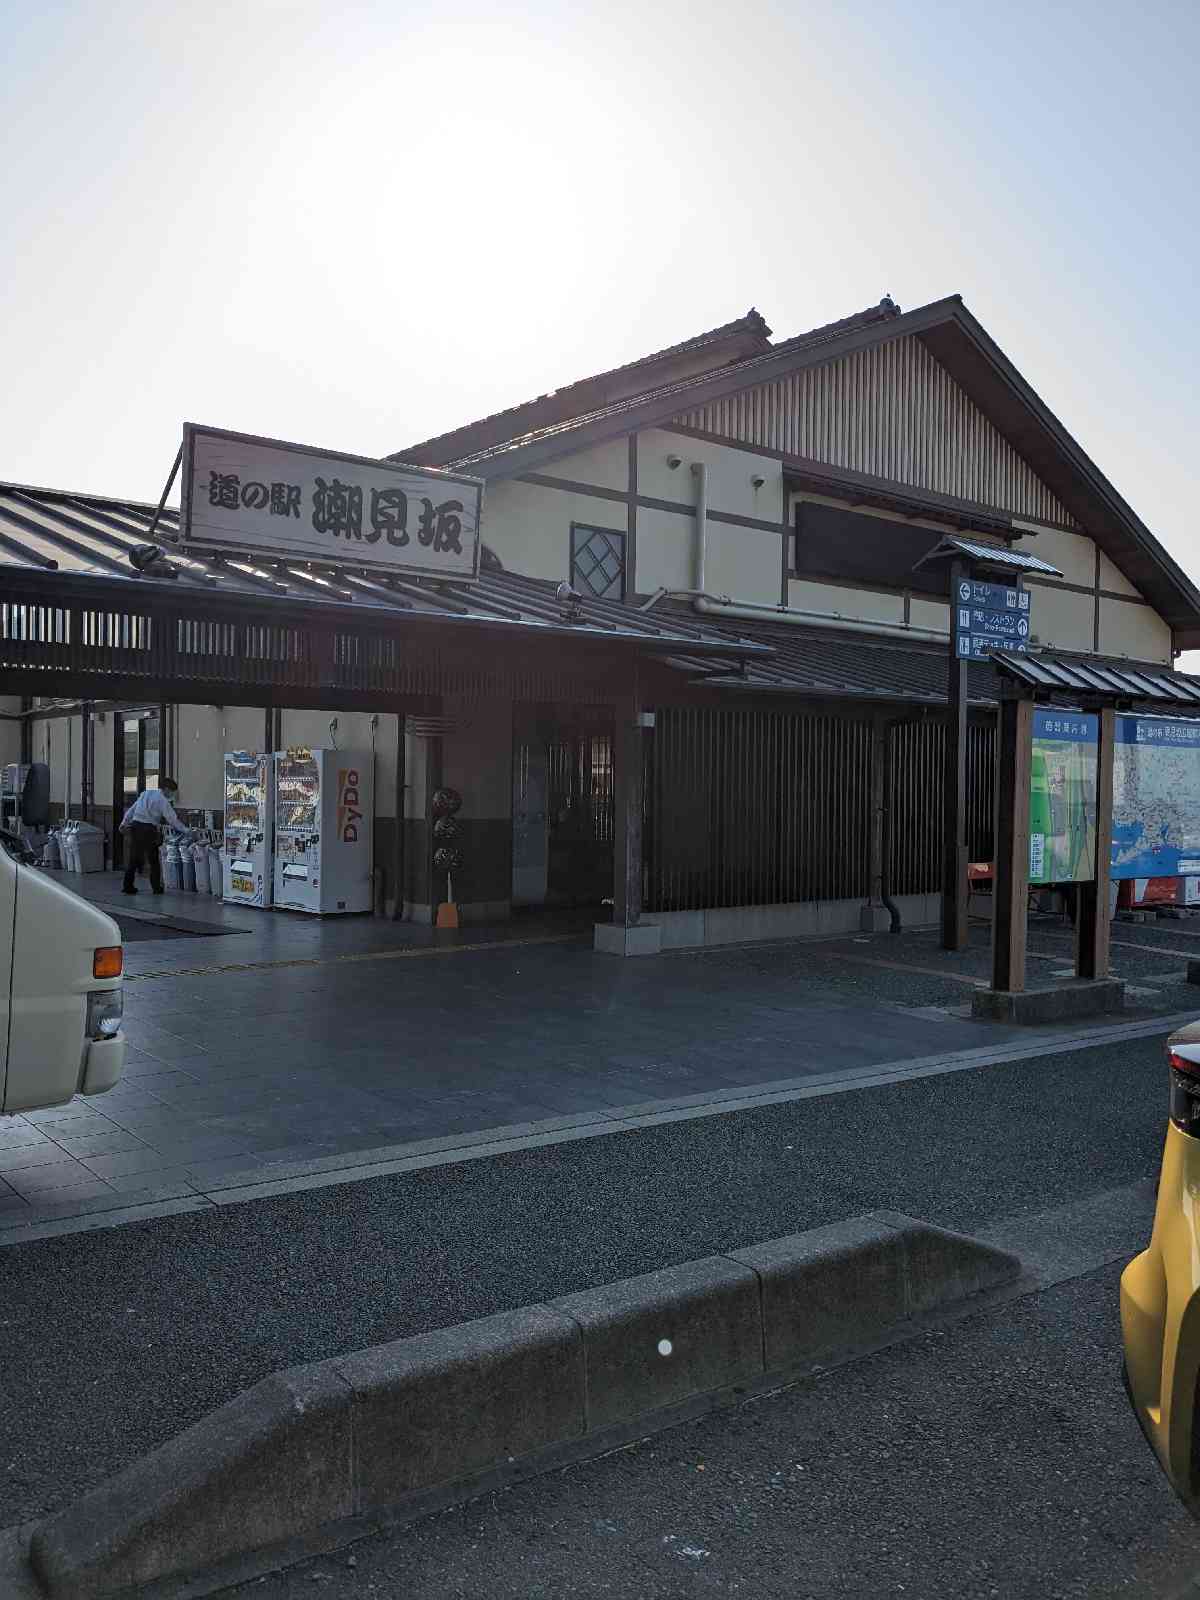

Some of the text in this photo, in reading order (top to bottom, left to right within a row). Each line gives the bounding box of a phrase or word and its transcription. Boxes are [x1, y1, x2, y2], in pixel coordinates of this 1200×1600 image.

[208, 470, 464, 555] 道の駅 潮見坂
[343, 769, 362, 843] DyDo
